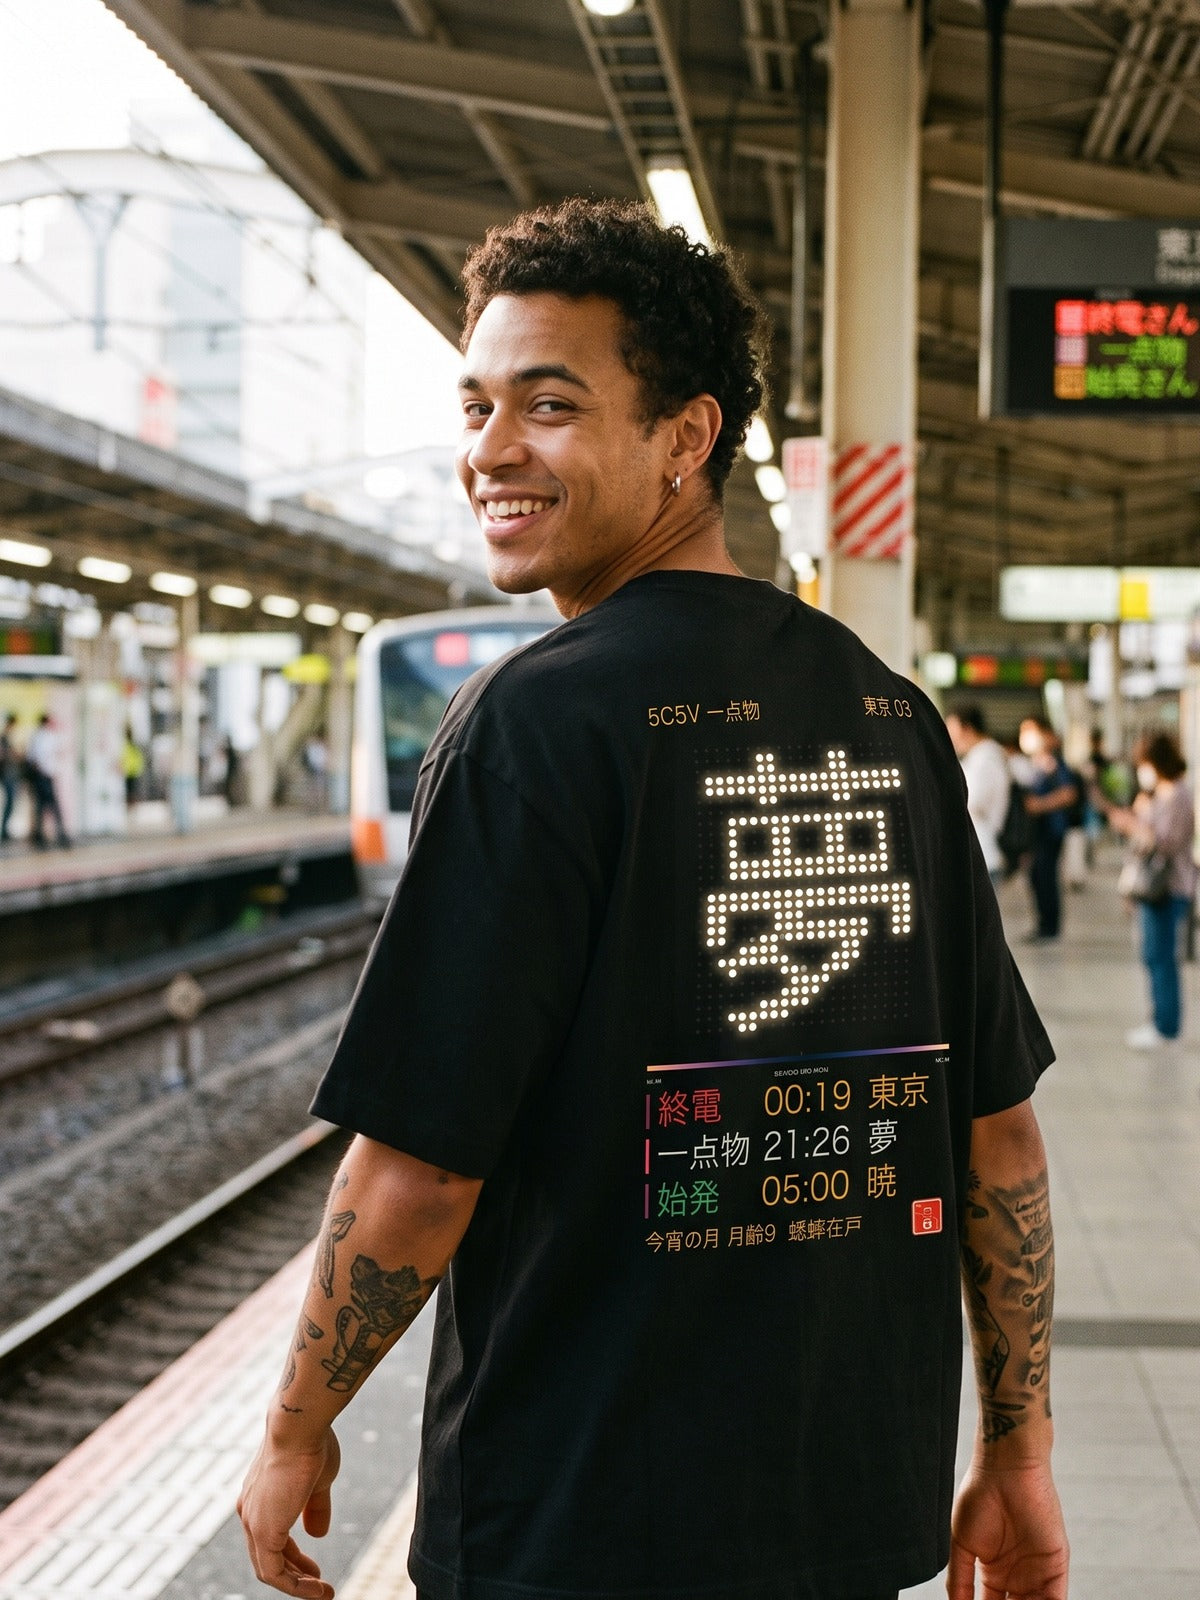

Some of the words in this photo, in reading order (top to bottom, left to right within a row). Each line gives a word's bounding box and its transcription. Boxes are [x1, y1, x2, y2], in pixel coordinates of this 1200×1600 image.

[648, 703, 700, 727] 5C5V
[706, 699, 760, 723] 一点物
[862, 695, 892, 718] 東京
[894, 698, 913, 718] 03
[704, 749, 912, 1033] 夢
[658, 1088, 722, 1128] 終電
[764, 1080, 851, 1116] 00:19
[868, 1072, 930, 1110] 東京
[657, 1132, 750, 1171] 一点物
[764, 1125, 850, 1162] 21:26
[868, 1119, 898, 1155] 夢
[657, 1180, 719, 1218] 始発
[762, 1170, 850, 1206] 05:00
[867, 1163, 897, 1199] 暁
[645, 1228, 719, 1253] 今宵の月
[727, 1223, 776, 1248] 月齢9
